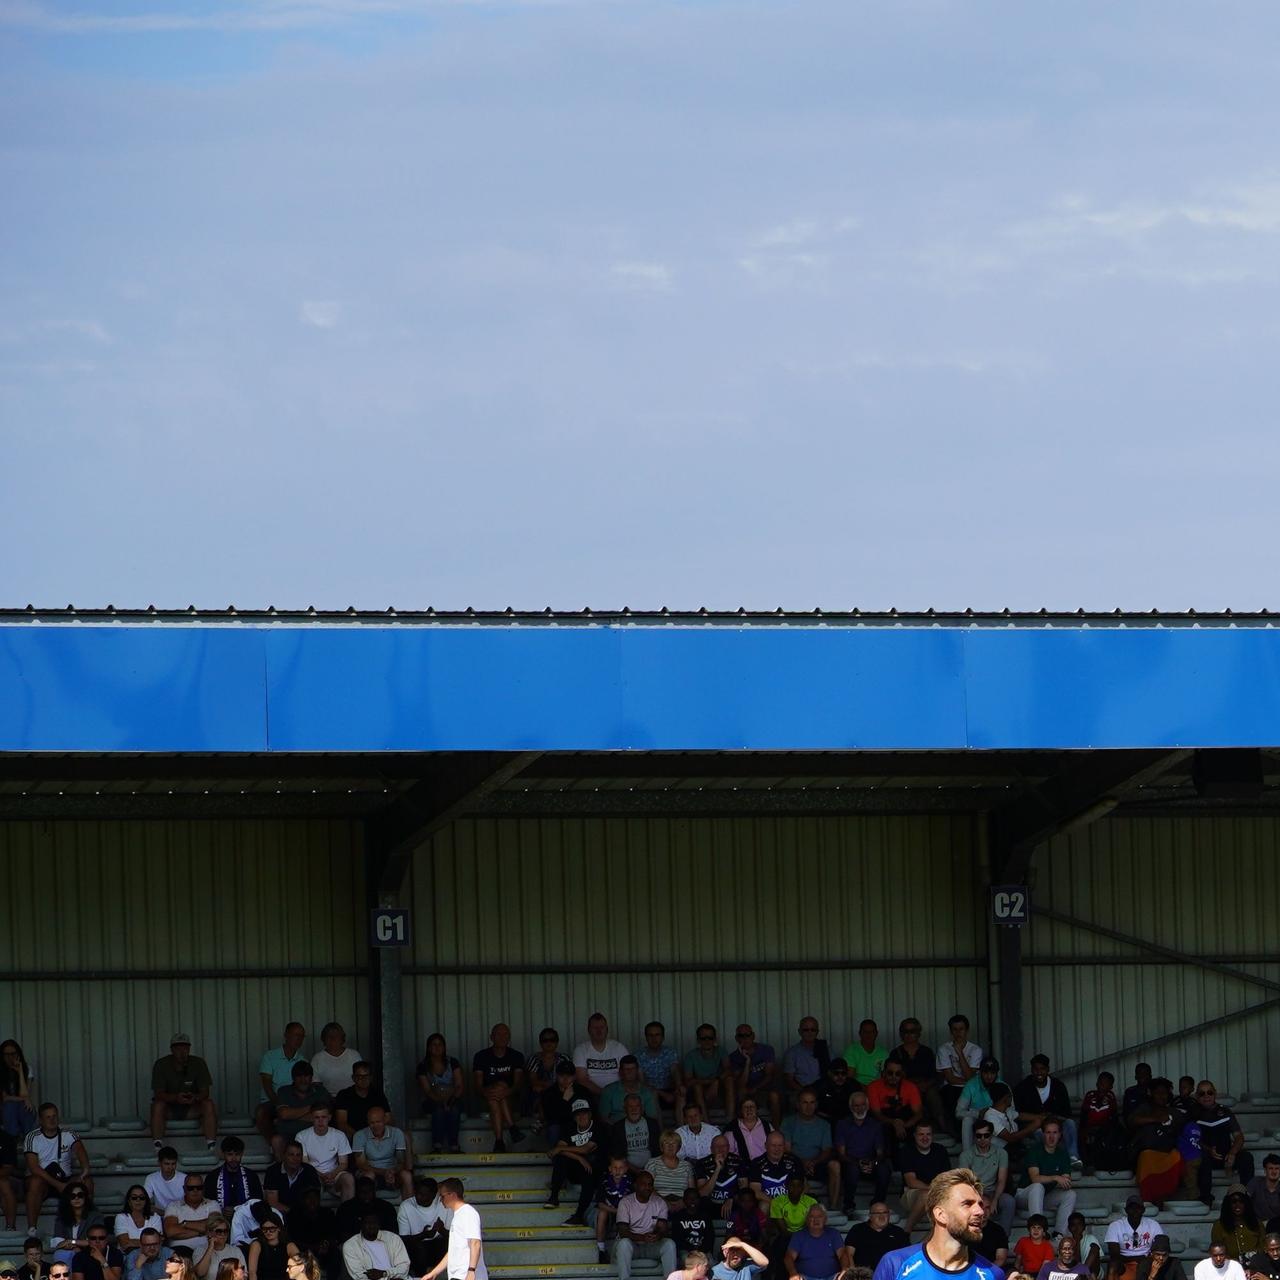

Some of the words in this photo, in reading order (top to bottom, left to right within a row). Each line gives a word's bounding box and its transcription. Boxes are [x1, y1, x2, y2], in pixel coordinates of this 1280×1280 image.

[994, 892, 1024, 918] C2
[376, 915, 404, 941] C1
[680, 1220, 706, 1230] NASA
